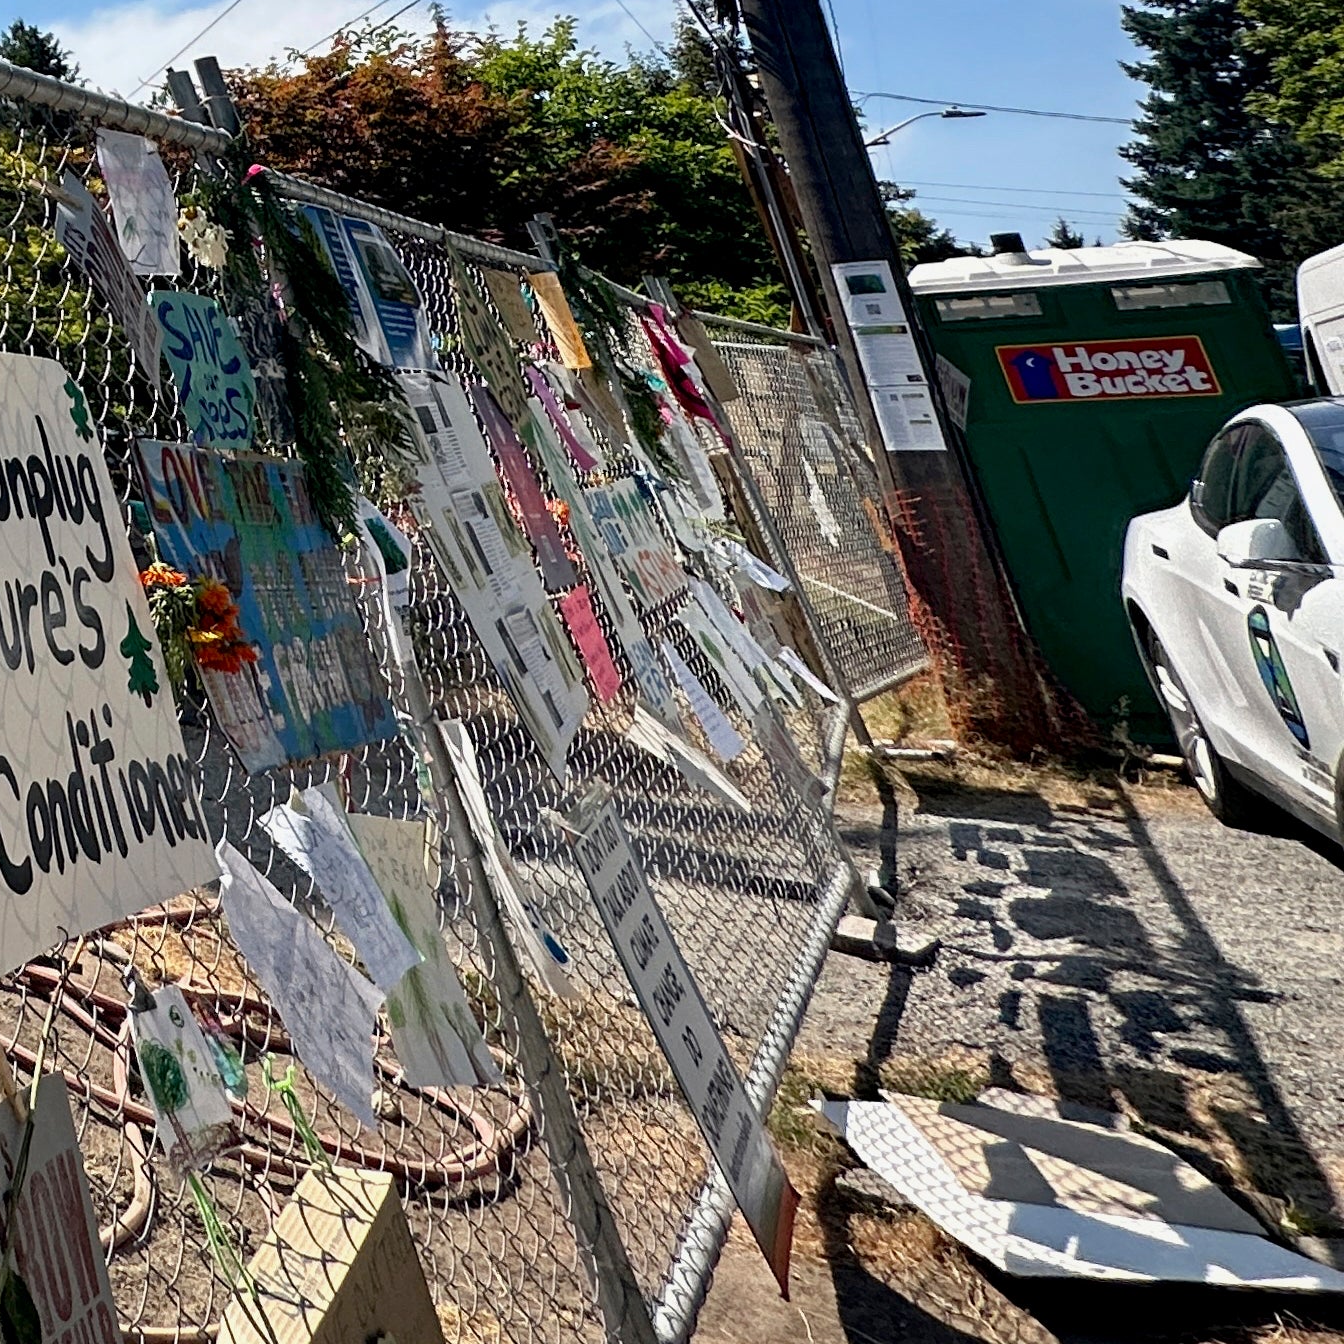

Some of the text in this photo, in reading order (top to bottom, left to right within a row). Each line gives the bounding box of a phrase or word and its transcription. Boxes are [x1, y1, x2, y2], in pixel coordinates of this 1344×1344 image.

[1052, 347, 1185, 373] Honey
[1064, 366, 1212, 396] Bucket
[630, 913, 660, 971] CLIMATE
[682, 1025, 703, 1068] DO
